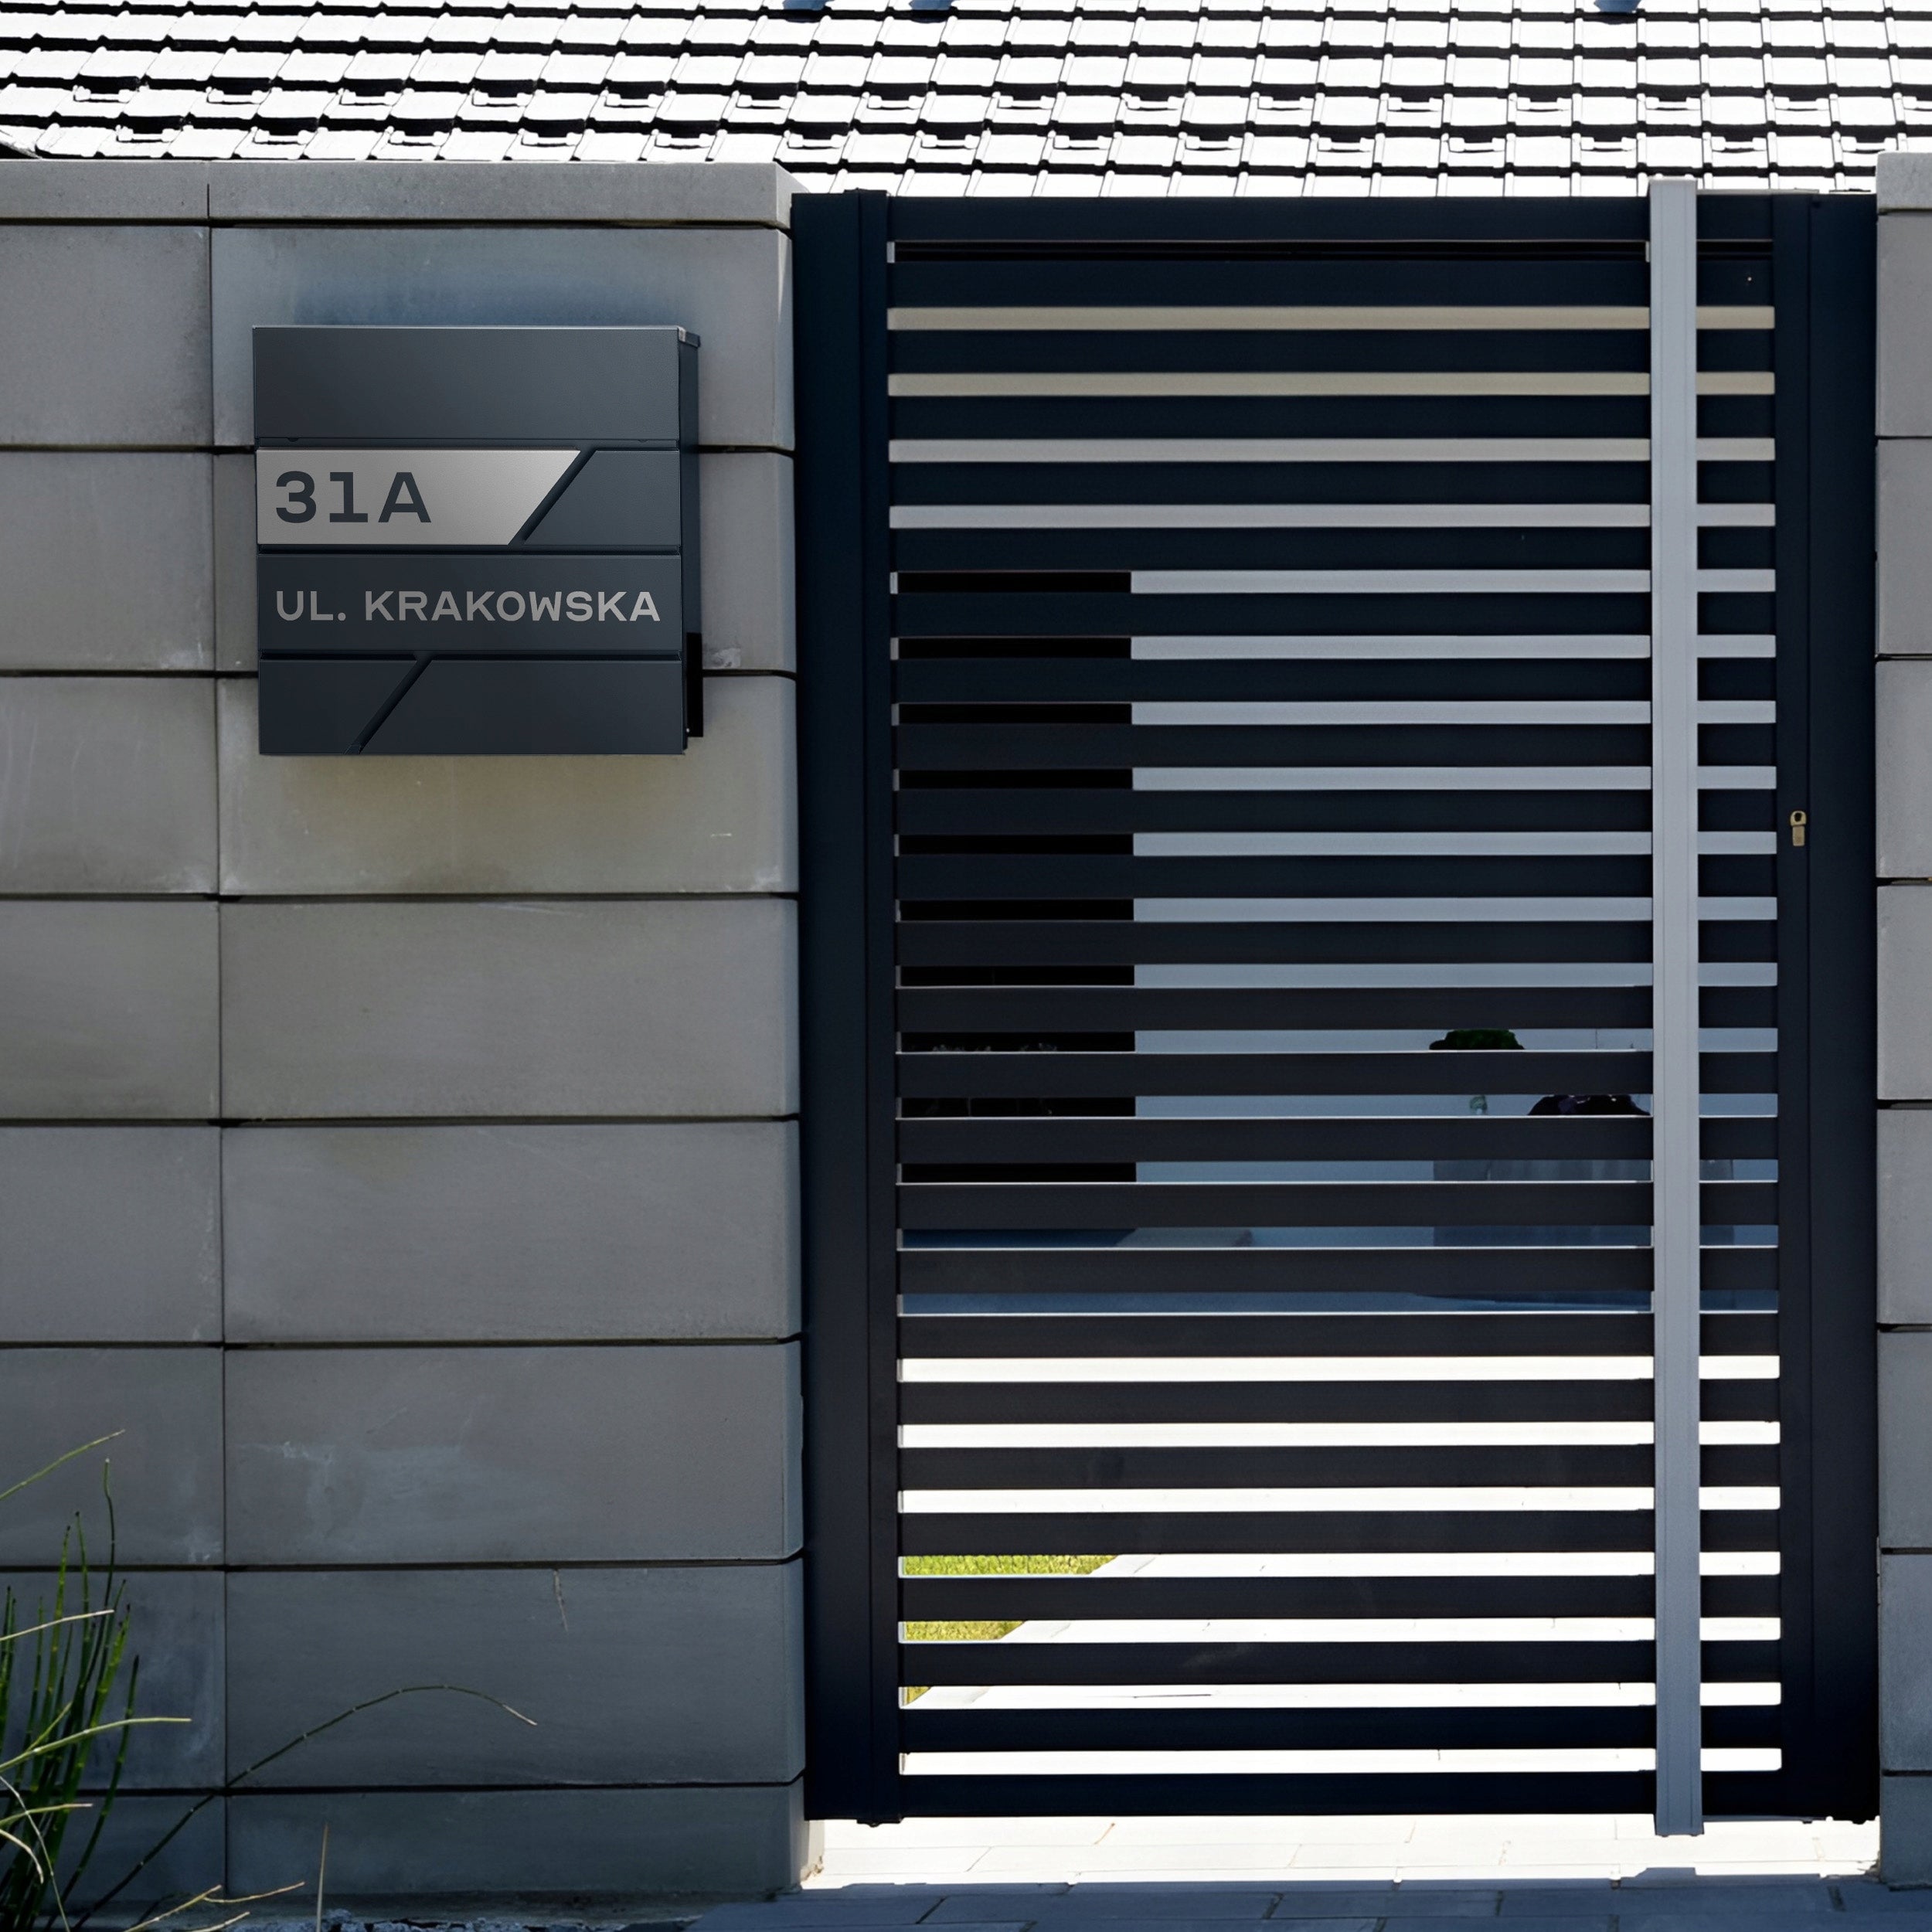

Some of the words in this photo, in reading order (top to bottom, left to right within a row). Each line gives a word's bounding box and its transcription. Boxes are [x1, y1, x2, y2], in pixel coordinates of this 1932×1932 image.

[275, 471, 432, 524] 31A
[276, 590, 346, 621] UL.
[366, 590, 661, 621] KRAKOWSKA
